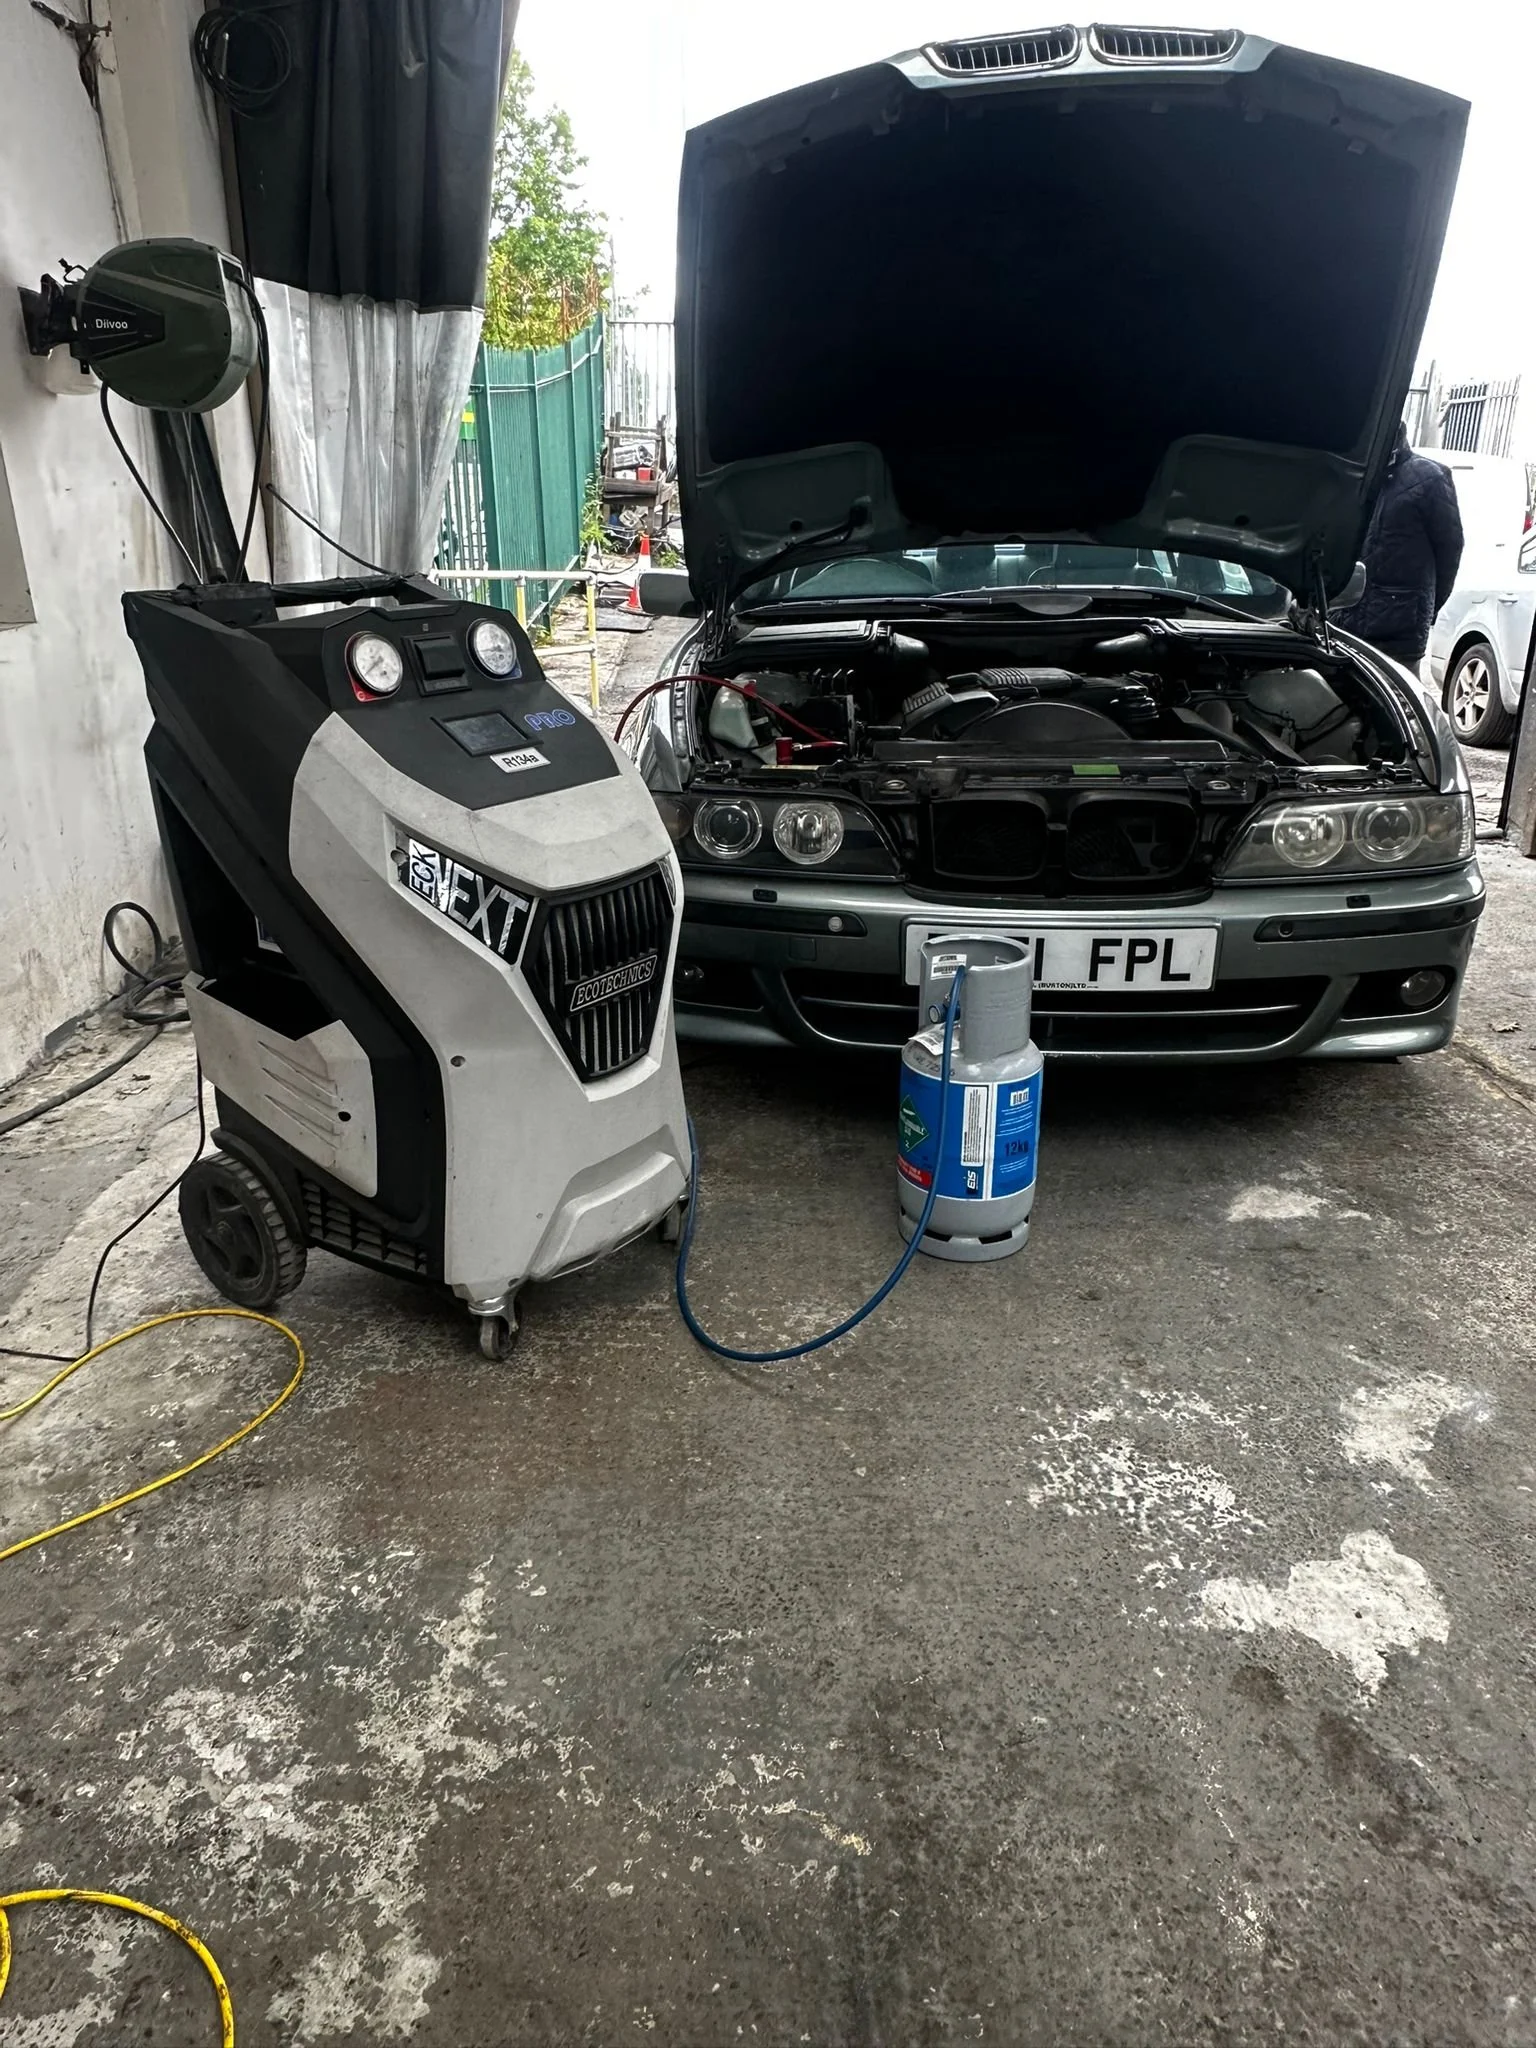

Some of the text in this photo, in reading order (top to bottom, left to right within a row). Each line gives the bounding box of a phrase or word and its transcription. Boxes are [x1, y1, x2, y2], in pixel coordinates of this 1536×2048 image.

[95, 318, 128, 329] Diivoo
[524, 708, 576, 731] PRO
[502, 754, 540, 768] R134a
[436, 852, 530, 955] NEXT
[1088, 937, 1191, 982] FPL
[576, 960, 653, 1006] ECOTECHNICS
